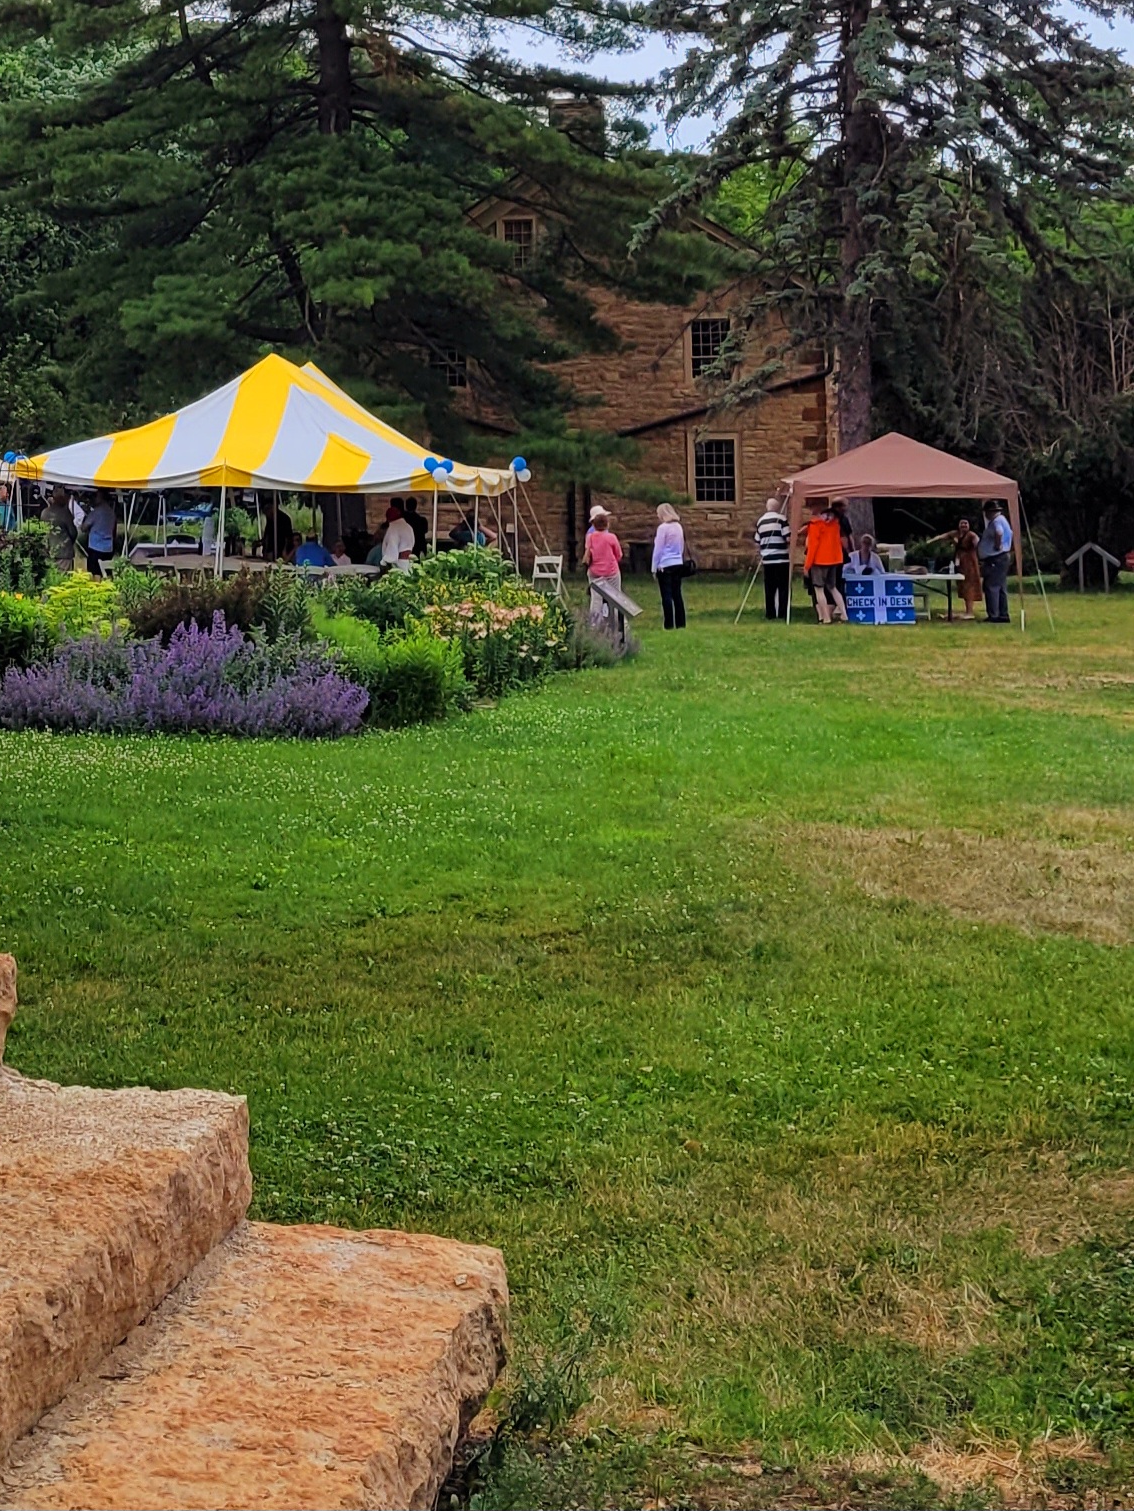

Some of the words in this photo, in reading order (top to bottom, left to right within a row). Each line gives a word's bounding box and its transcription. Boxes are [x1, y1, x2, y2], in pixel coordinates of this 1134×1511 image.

[847, 597, 875, 607] CHECK
[879, 597, 887, 607] IN
[890, 596, 913, 606] DESK
